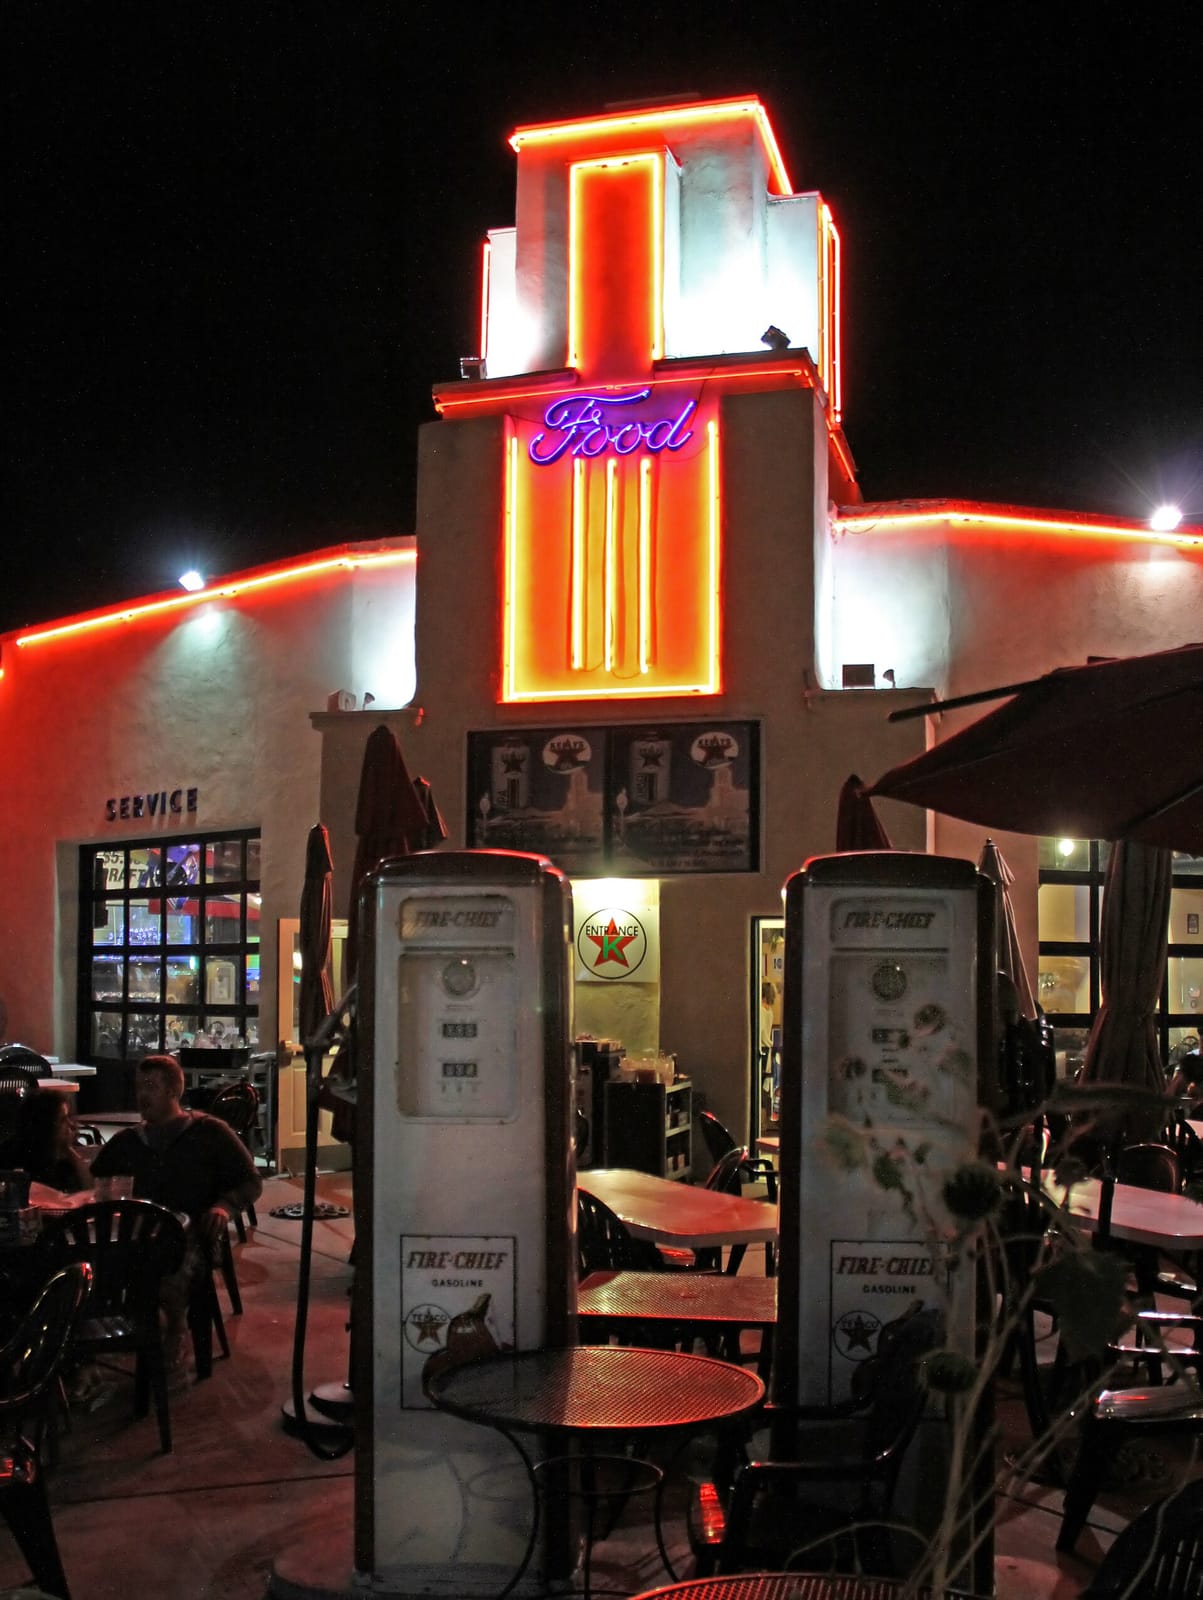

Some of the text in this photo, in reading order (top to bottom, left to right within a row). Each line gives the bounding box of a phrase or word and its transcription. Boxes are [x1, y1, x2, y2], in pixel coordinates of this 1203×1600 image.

[529, 388, 697, 466] Food
[105, 787, 199, 822] SERVICE
[414, 911, 502, 928] FIRE-CHIEF
[844, 911, 936, 929] FIRE-CHIEF
[585, 925, 639, 936] ENTRANCE
[602, 936, 625, 960] K
[406, 1251, 508, 1269] FIRE-CHIEF
[431, 1279, 483, 1288] GASOLINE
[862, 1285, 916, 1293] GASOLINE
